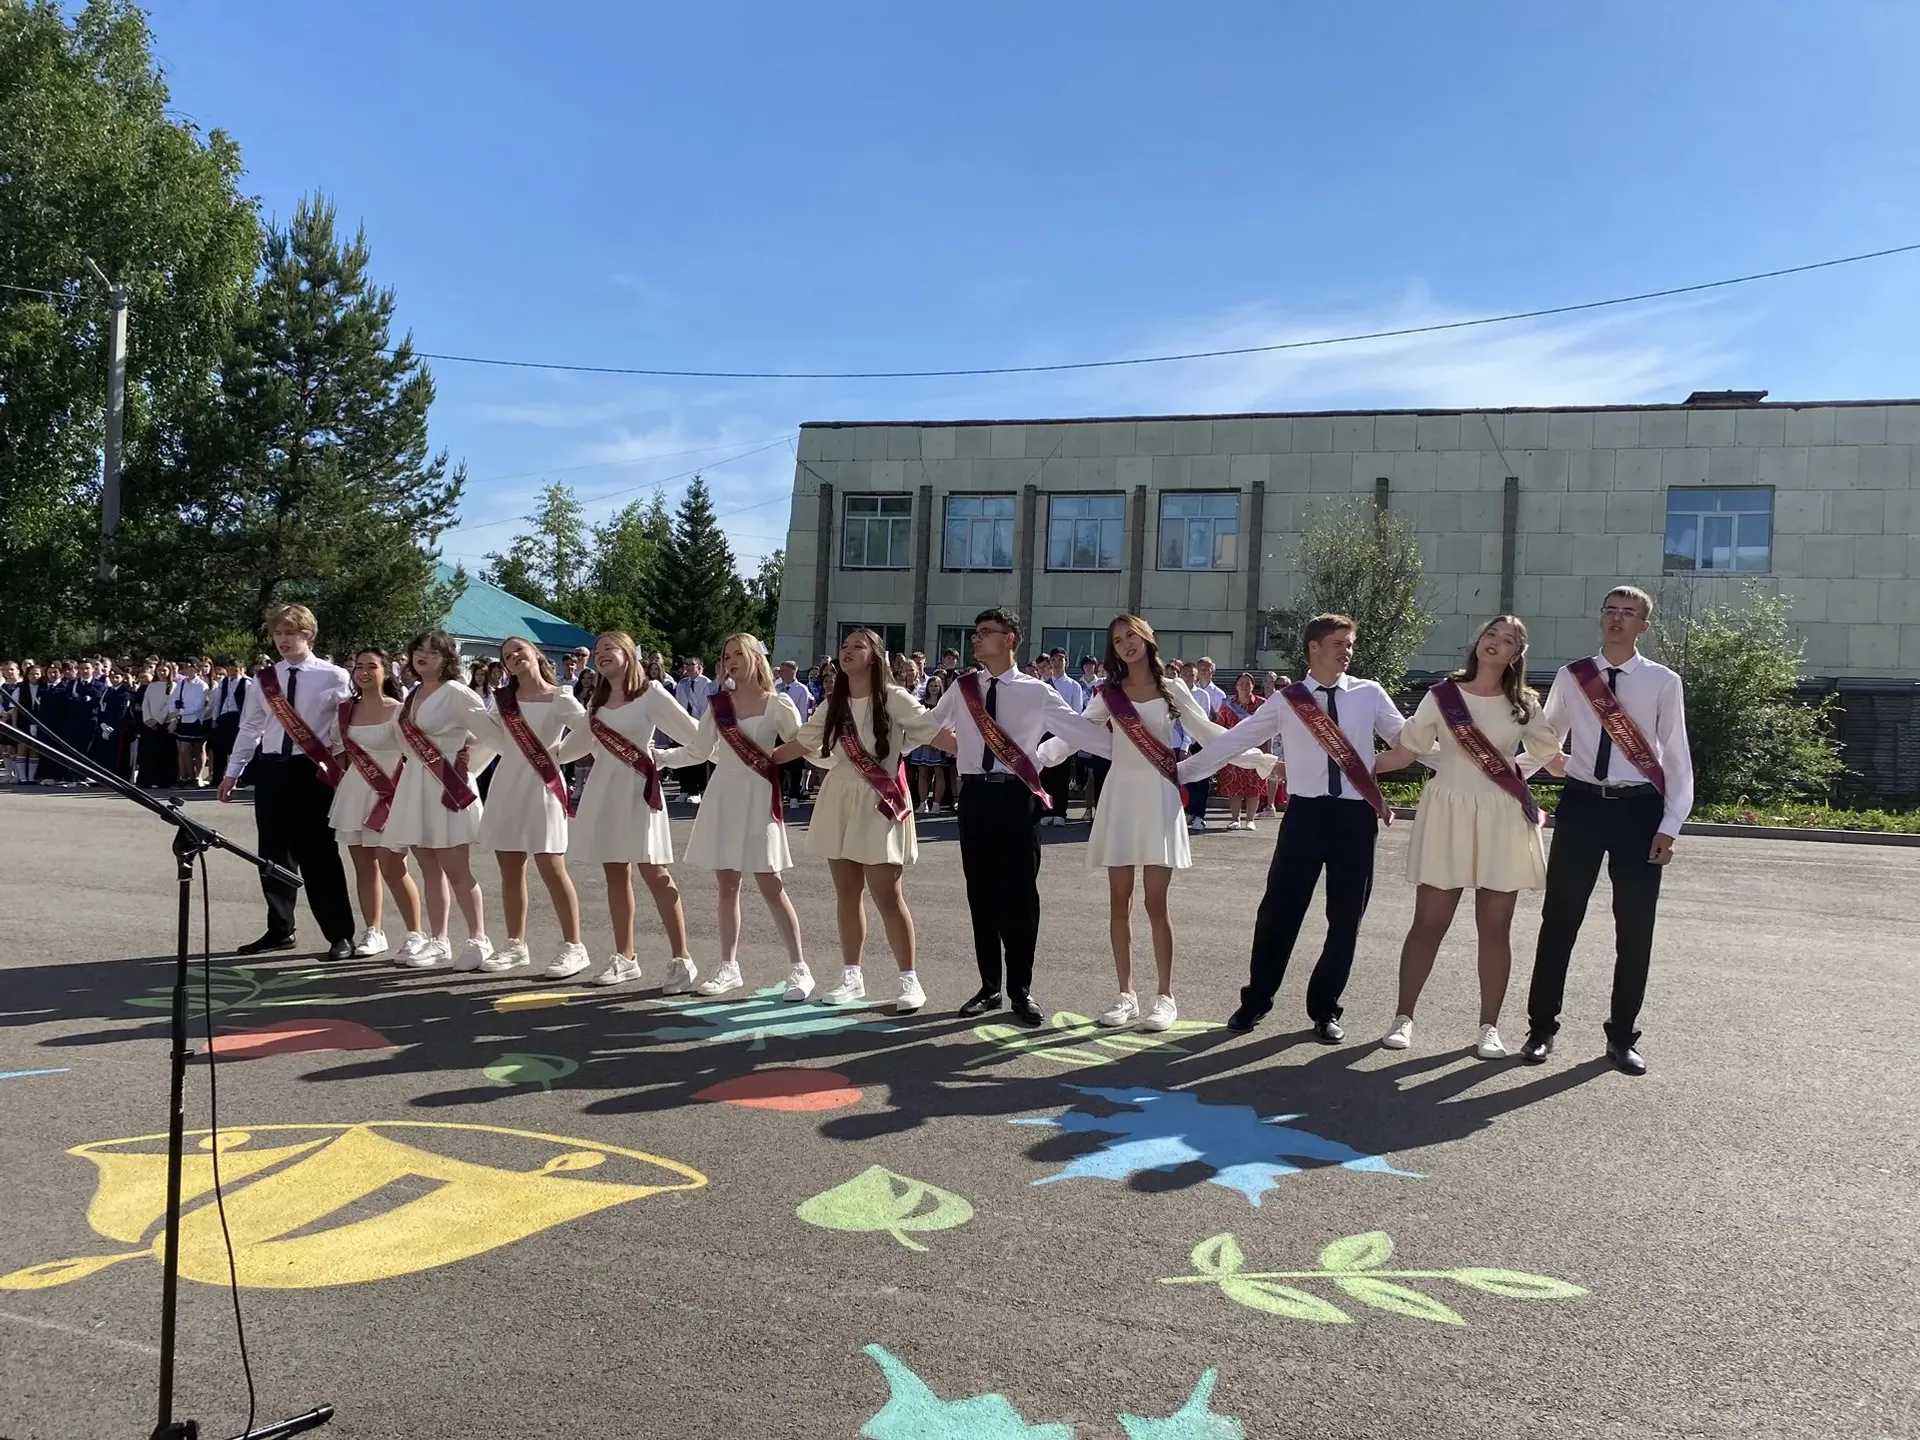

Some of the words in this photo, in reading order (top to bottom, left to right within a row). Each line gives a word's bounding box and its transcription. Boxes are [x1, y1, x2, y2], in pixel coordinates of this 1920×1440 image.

[1309, 715, 1344, 754] Выпускник
[1605, 710, 1638, 754] Выпускник
[1002, 745, 1020, 764] 2026
[363, 765, 382, 780] 2026
[1484, 757, 1504, 775] 2026
